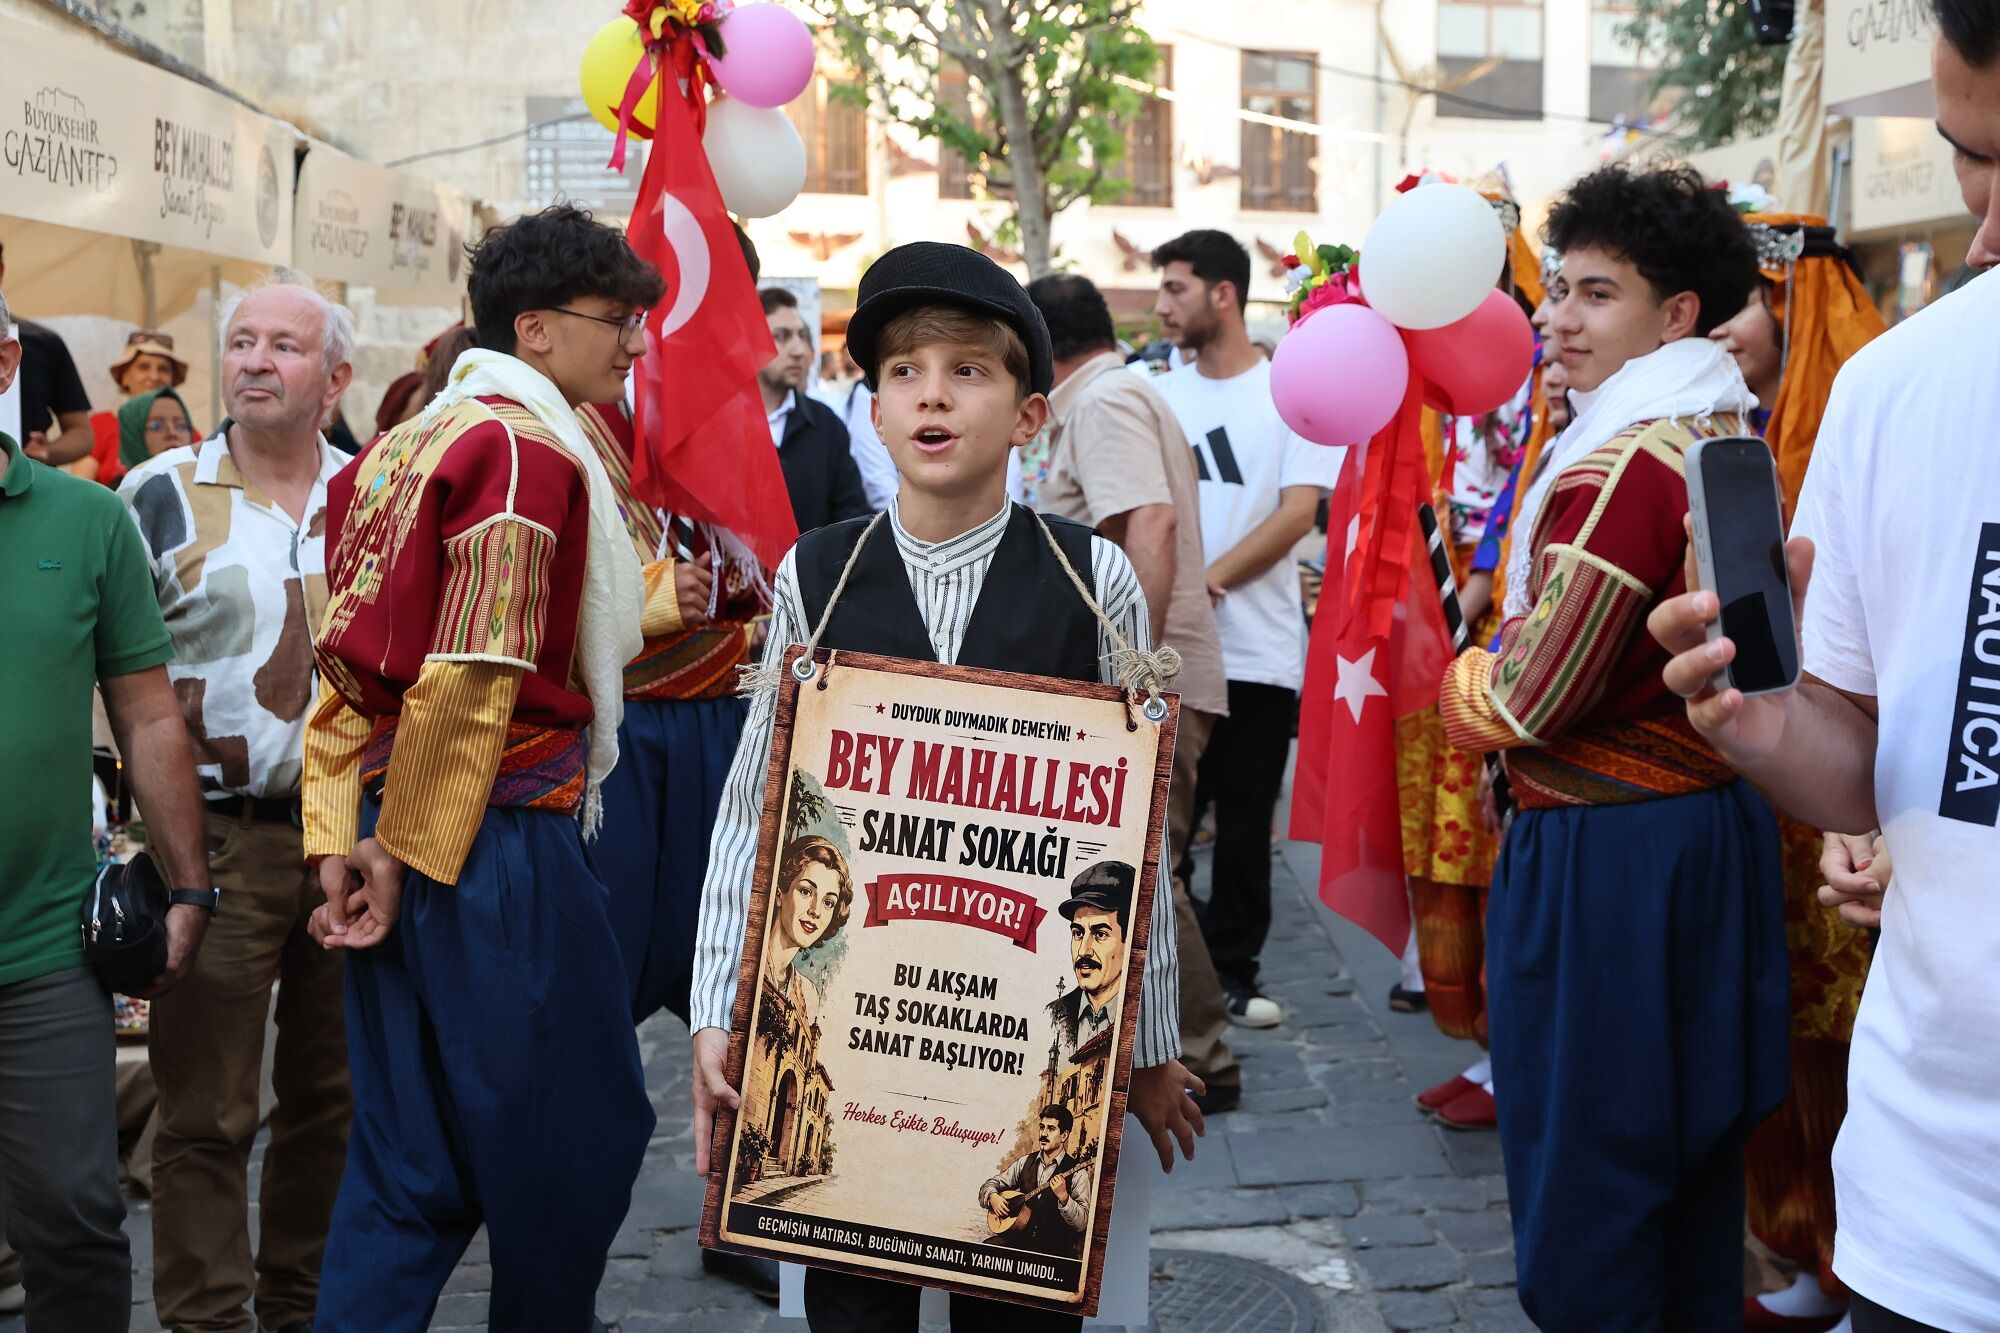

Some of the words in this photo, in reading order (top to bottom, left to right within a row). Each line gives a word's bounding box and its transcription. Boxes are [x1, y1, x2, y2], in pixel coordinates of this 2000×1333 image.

[154, 117, 180, 176] BEY
[891, 702, 942, 725] DUYDUK
[944, 709, 1009, 734] DUYMADIK
[1011, 718, 1072, 743] DEMEYİN!
[824, 729, 904, 796] BEY
[906, 740, 1128, 828] MAHALLESİ
[858, 808, 956, 863] SANAT
[958, 823, 1071, 880] SOKAĞI
[885, 882, 1026, 931] AÇILIYOR!
[893, 963, 923, 989] BU
[925, 968, 998, 1002] AKŞAM
[854, 991, 891, 1024] TAŞ
[895, 999, 1029, 1042] SOKAKLARDA
[847, 1026, 915, 1058] SANAT
[918, 1037, 1025, 1076] BAŞLIYOR!
[842, 1101, 887, 1125] Herkes
[890, 1109, 928, 1133] Eşikte
[930, 1116, 1005, 1148] Buluşuyor!
[758, 1216, 810, 1238] GEÇMİŞİN
[812, 1225, 864, 1249] HATIRASI,
[868, 1235, 923, 1257] BUGÜNÜN
[925, 1245, 967, 1267] SANATI,
[971, 1252, 1014, 1273] YARININ
[1016, 1260, 1064, 1283] UMUDU...
